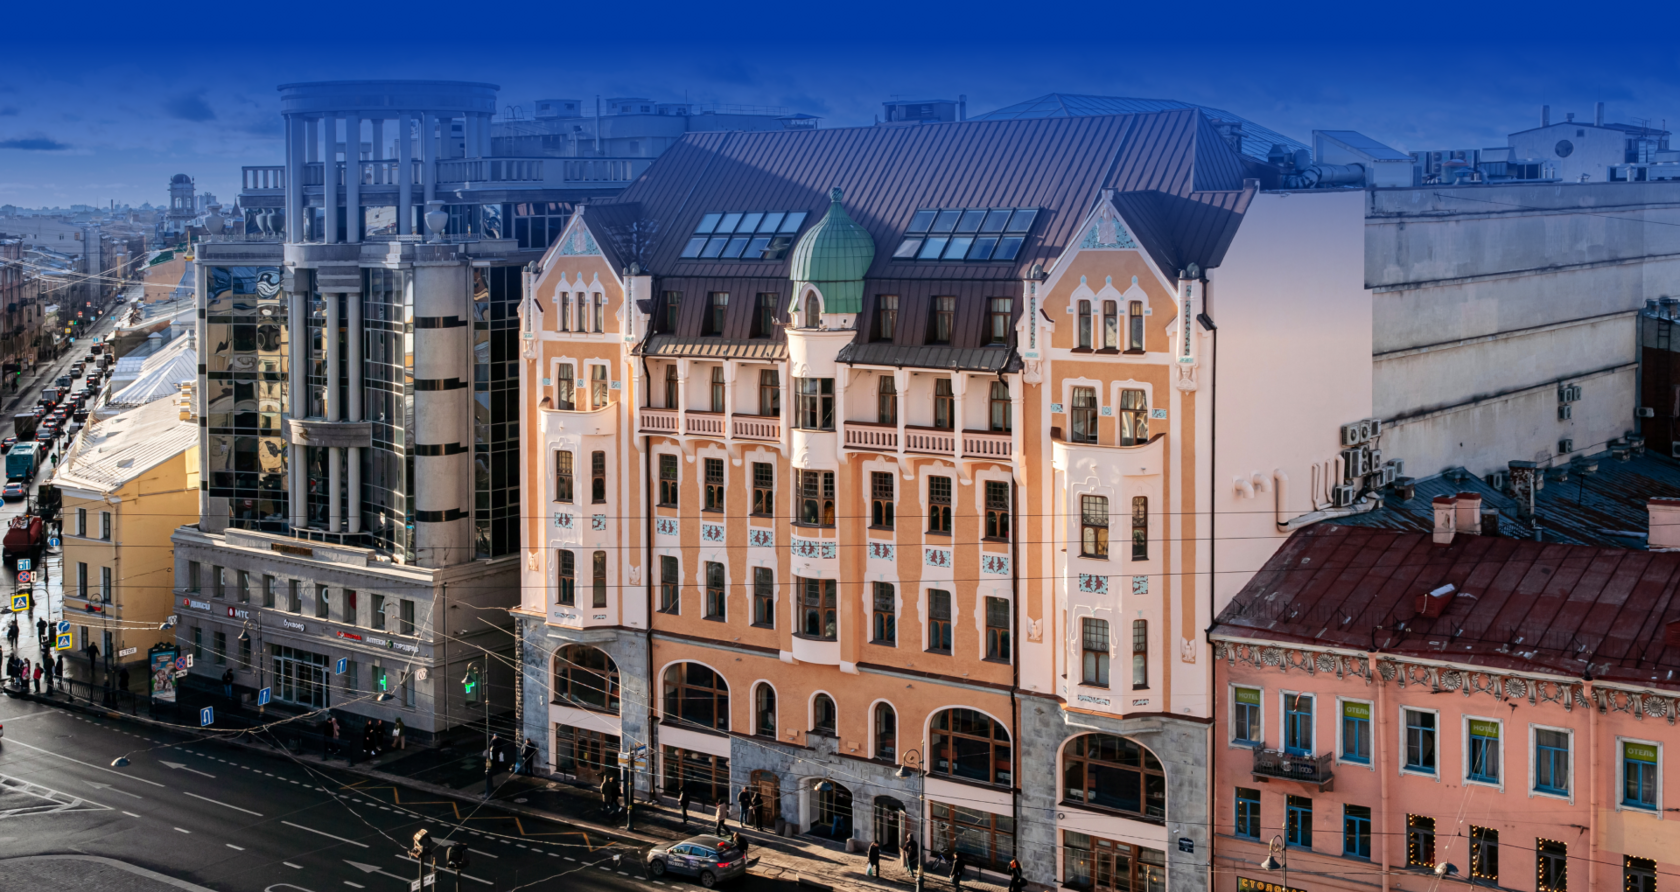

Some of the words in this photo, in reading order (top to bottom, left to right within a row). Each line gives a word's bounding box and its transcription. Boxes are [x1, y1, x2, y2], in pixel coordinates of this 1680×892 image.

[235, 609, 249, 620] МТС
[1238, 692, 1259, 701] HOTEL
[1346, 706, 1370, 716] ОТЕЛЬ
[1473, 724, 1497, 734] HOTEL
[1627, 747, 1655, 758] ОТЕЛЬ
